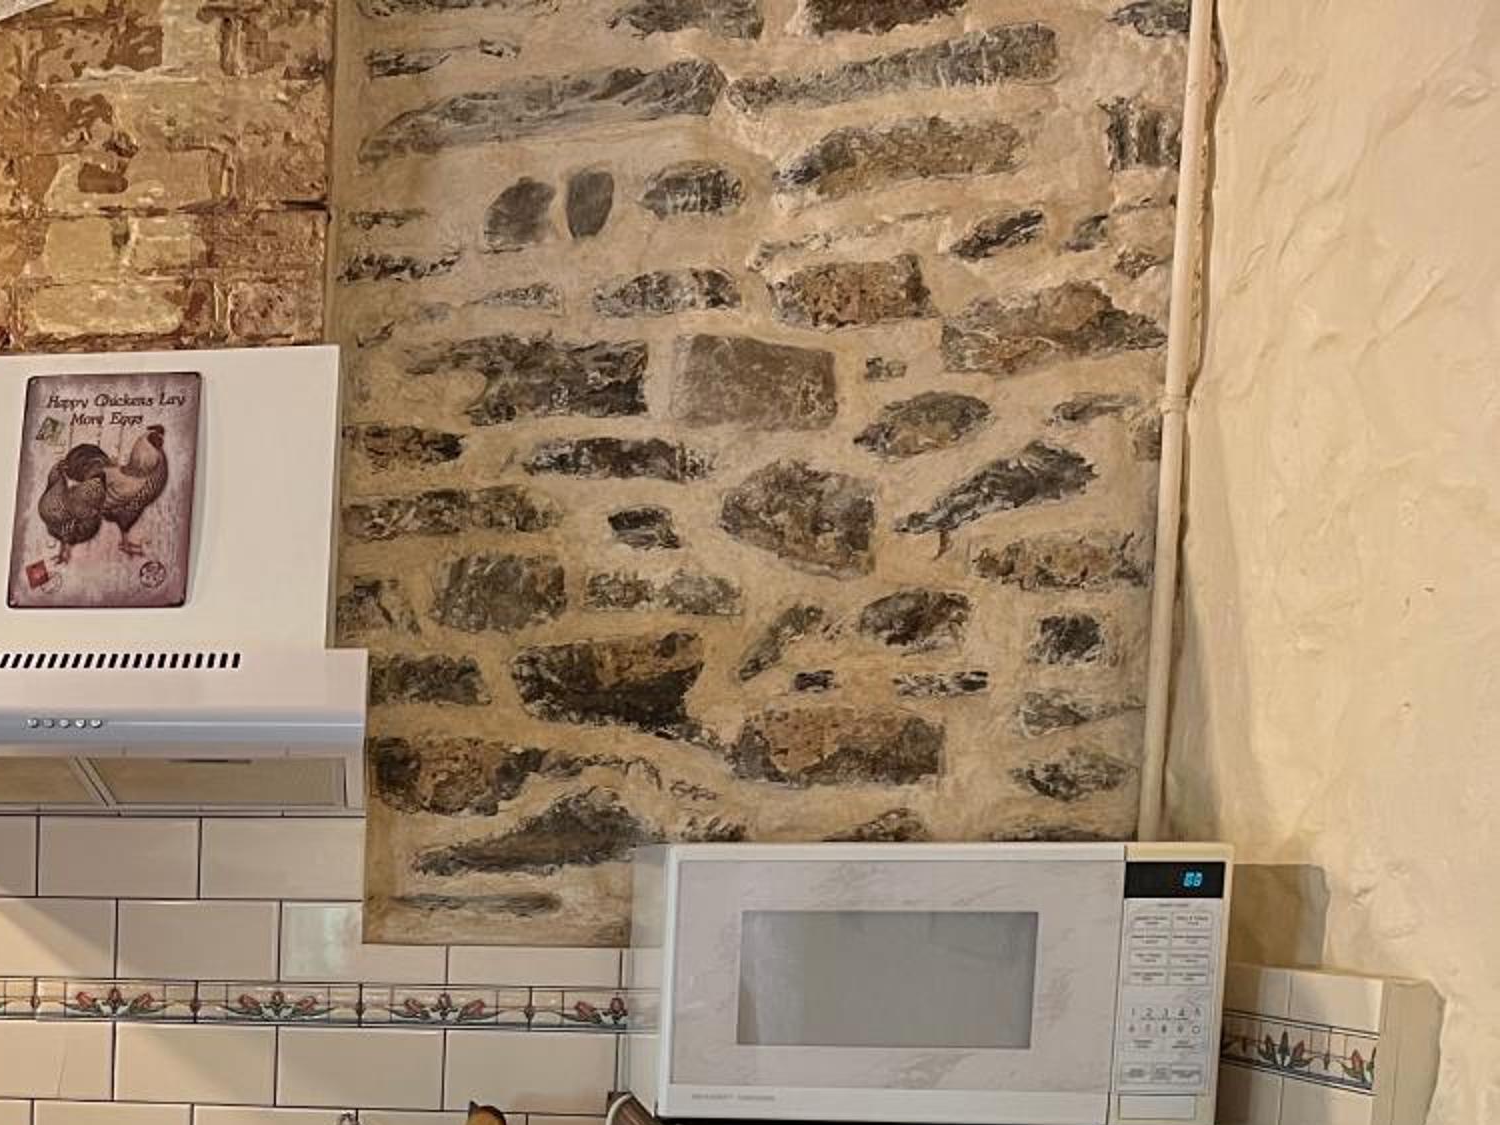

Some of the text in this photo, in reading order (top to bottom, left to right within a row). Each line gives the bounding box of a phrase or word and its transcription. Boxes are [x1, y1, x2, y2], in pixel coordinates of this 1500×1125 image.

[46, 392, 186, 411] Happy Chickens Lay
[69, 412, 144, 427] More Eggs
